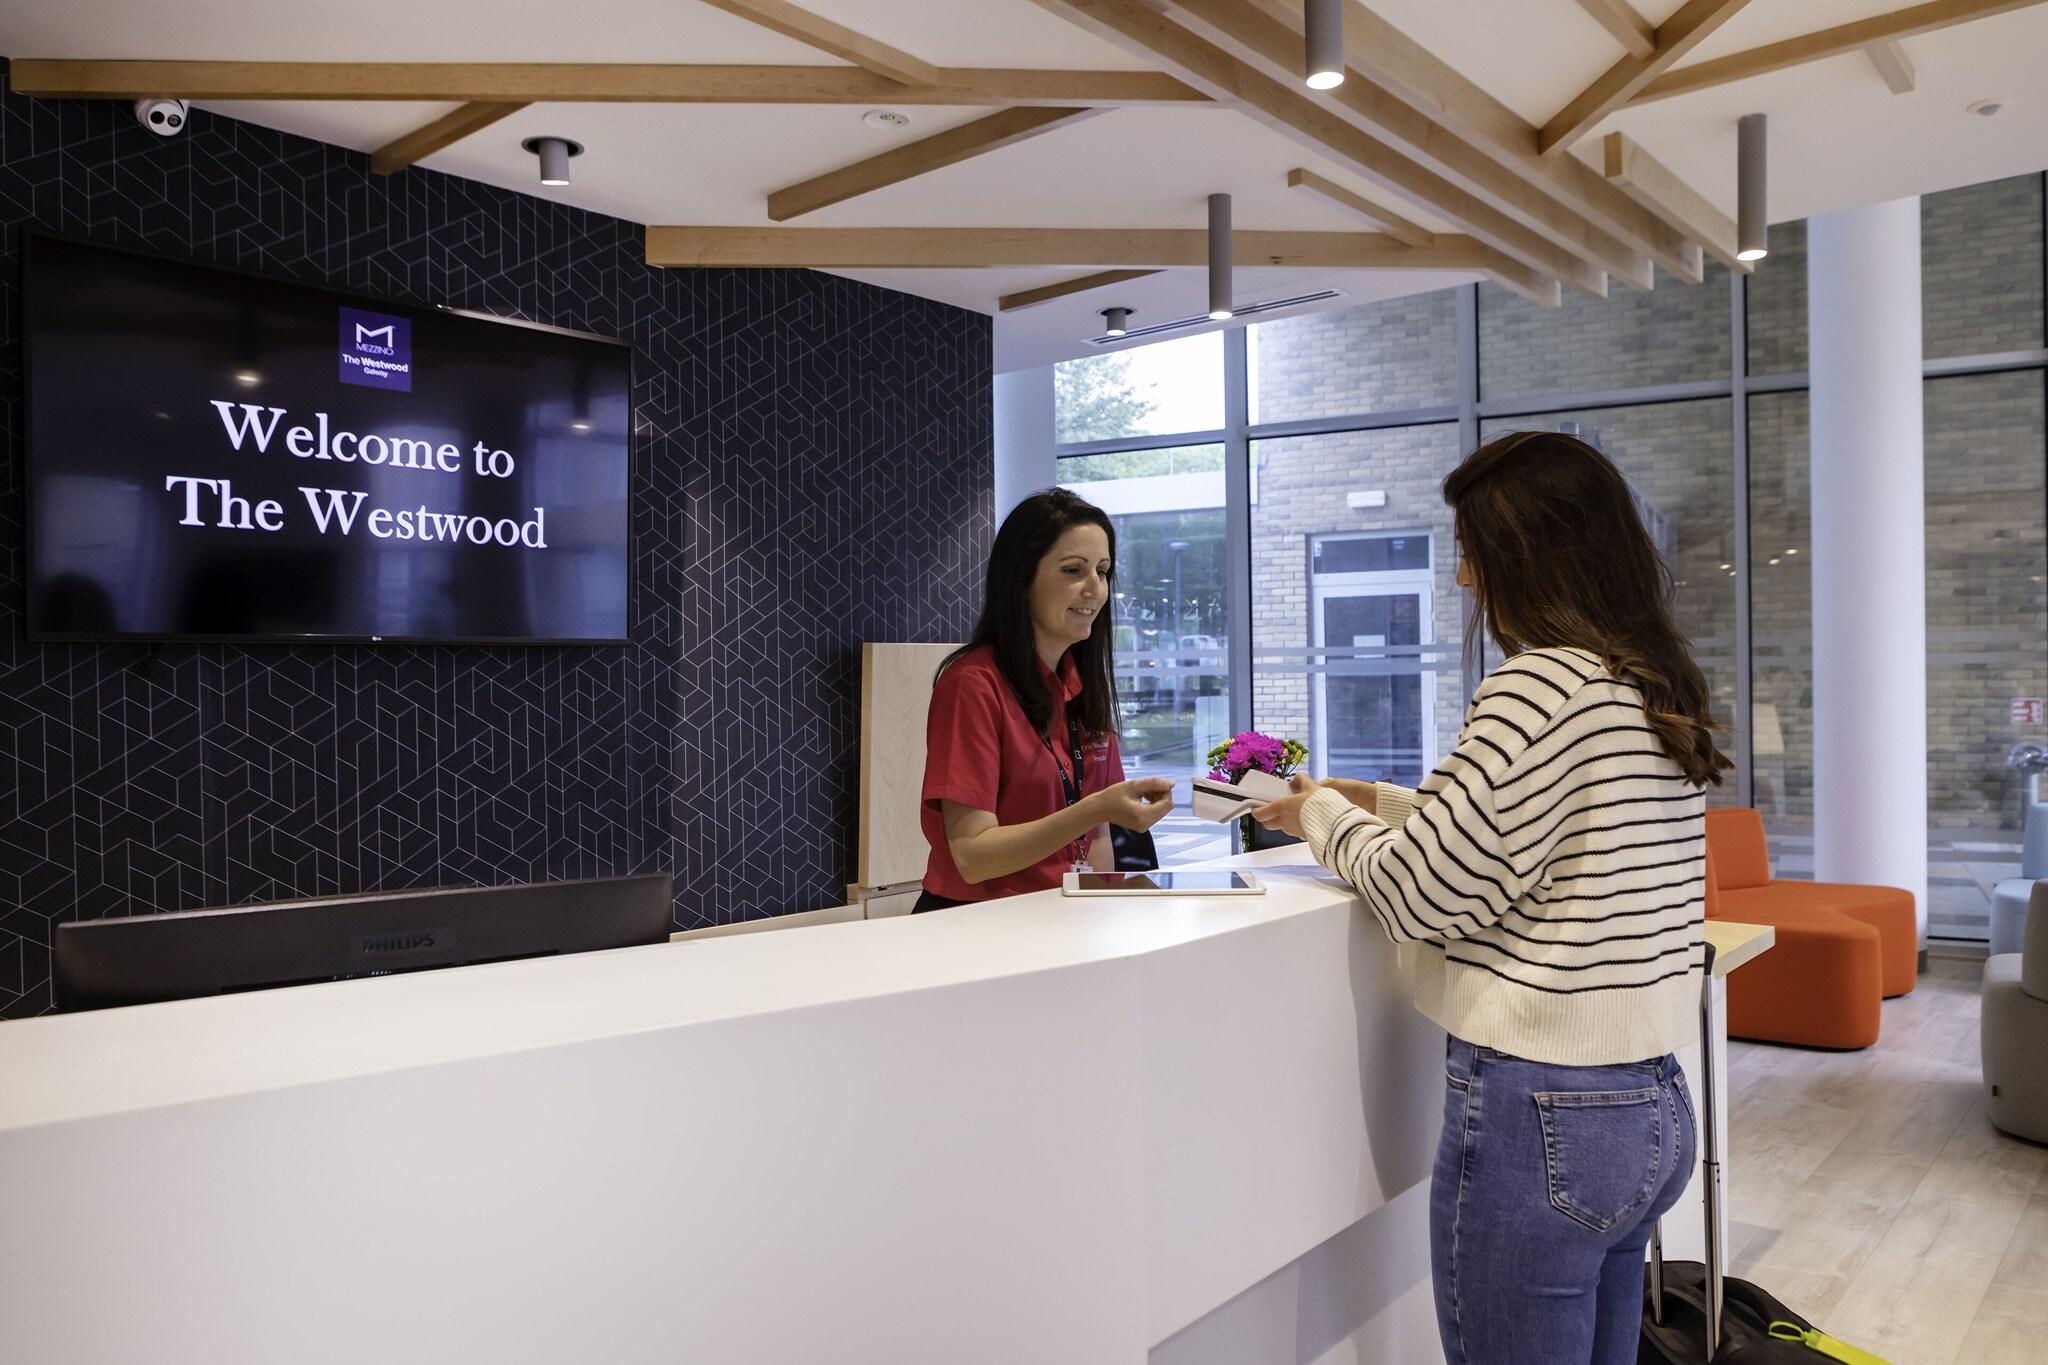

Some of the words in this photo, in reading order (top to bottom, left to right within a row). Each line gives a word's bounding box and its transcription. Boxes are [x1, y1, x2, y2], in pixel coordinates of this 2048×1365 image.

[356, 343, 394, 356] MEZZINO
[342, 353, 361, 366] The
[361, 356, 409, 373] Westwood
[210, 399, 460, 473] Welcome
[473, 440, 515, 478] to
[165, 474, 284, 531] The
[298, 486, 548, 549] Westwood
[361, 933, 435, 952] PHILIPS
